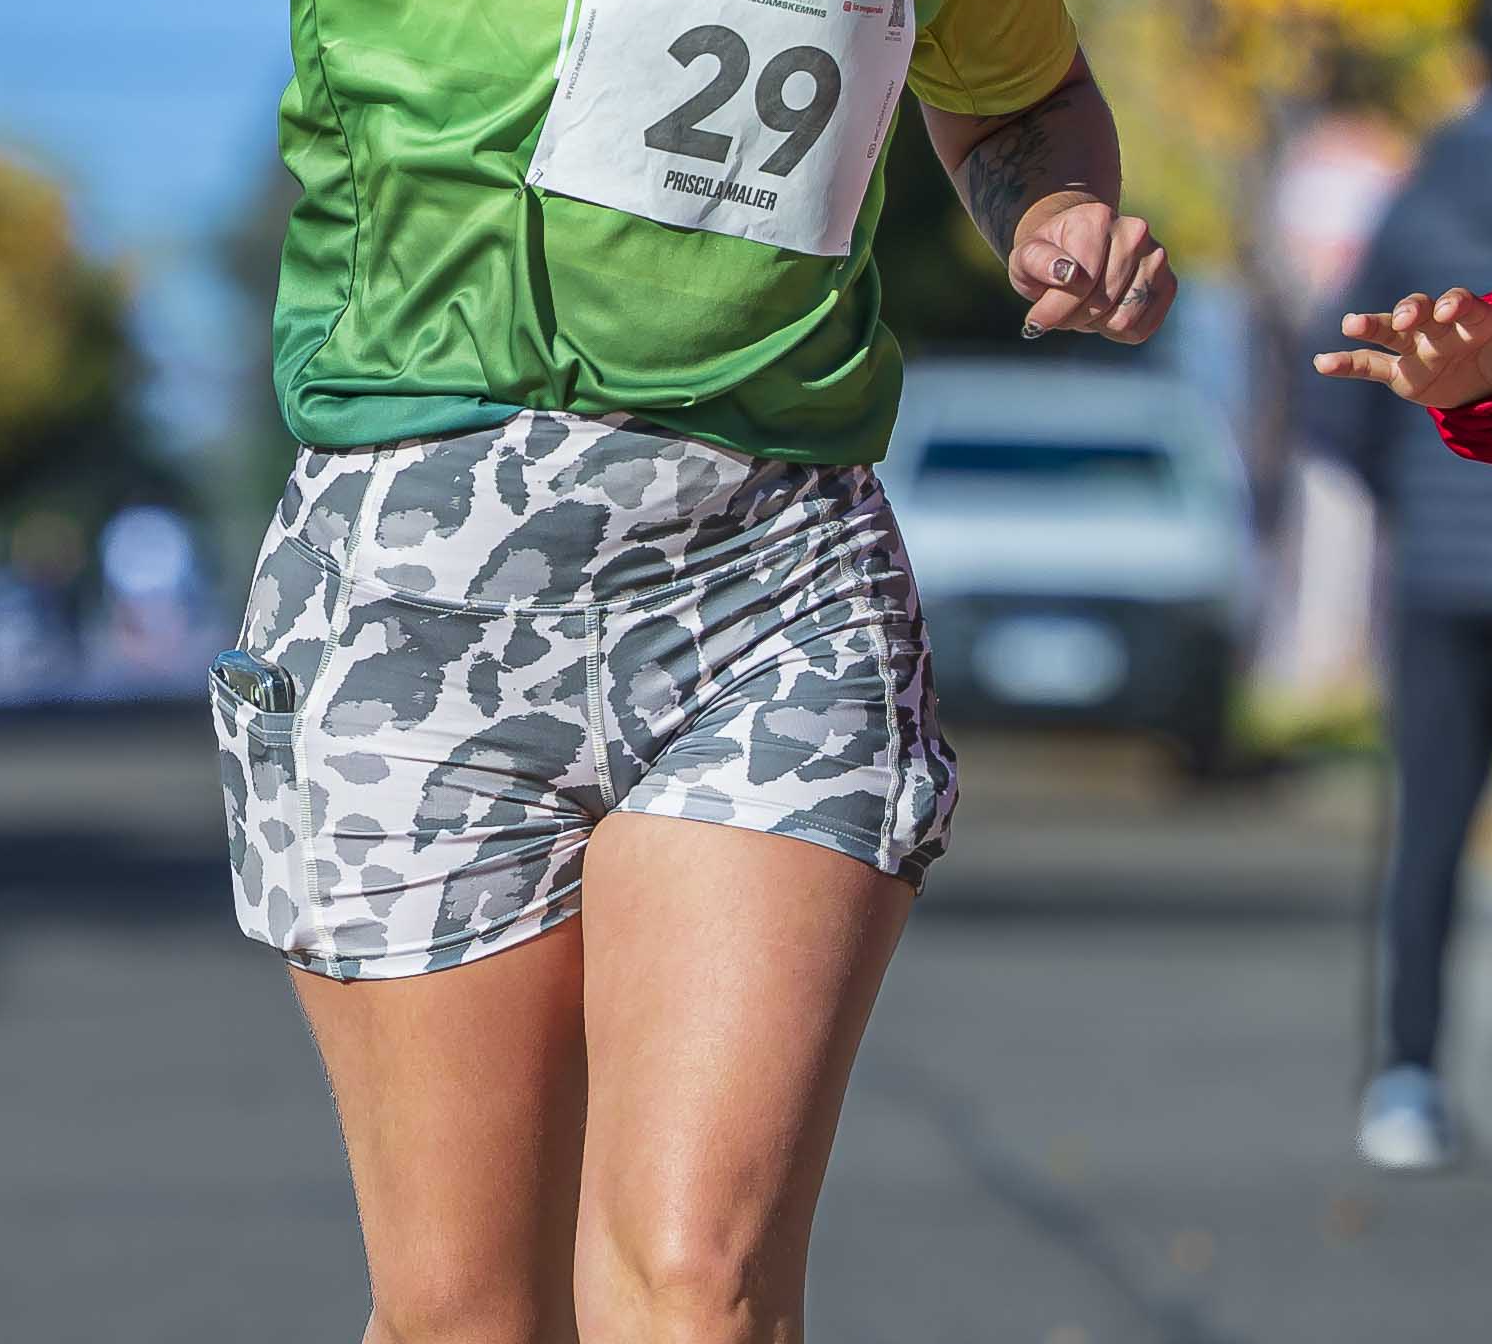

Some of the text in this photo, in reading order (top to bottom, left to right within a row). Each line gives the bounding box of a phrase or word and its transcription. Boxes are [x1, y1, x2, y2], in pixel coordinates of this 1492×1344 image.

[644, 24, 843, 178] 29
[663, 169, 778, 211] PRISCILA MALIER
